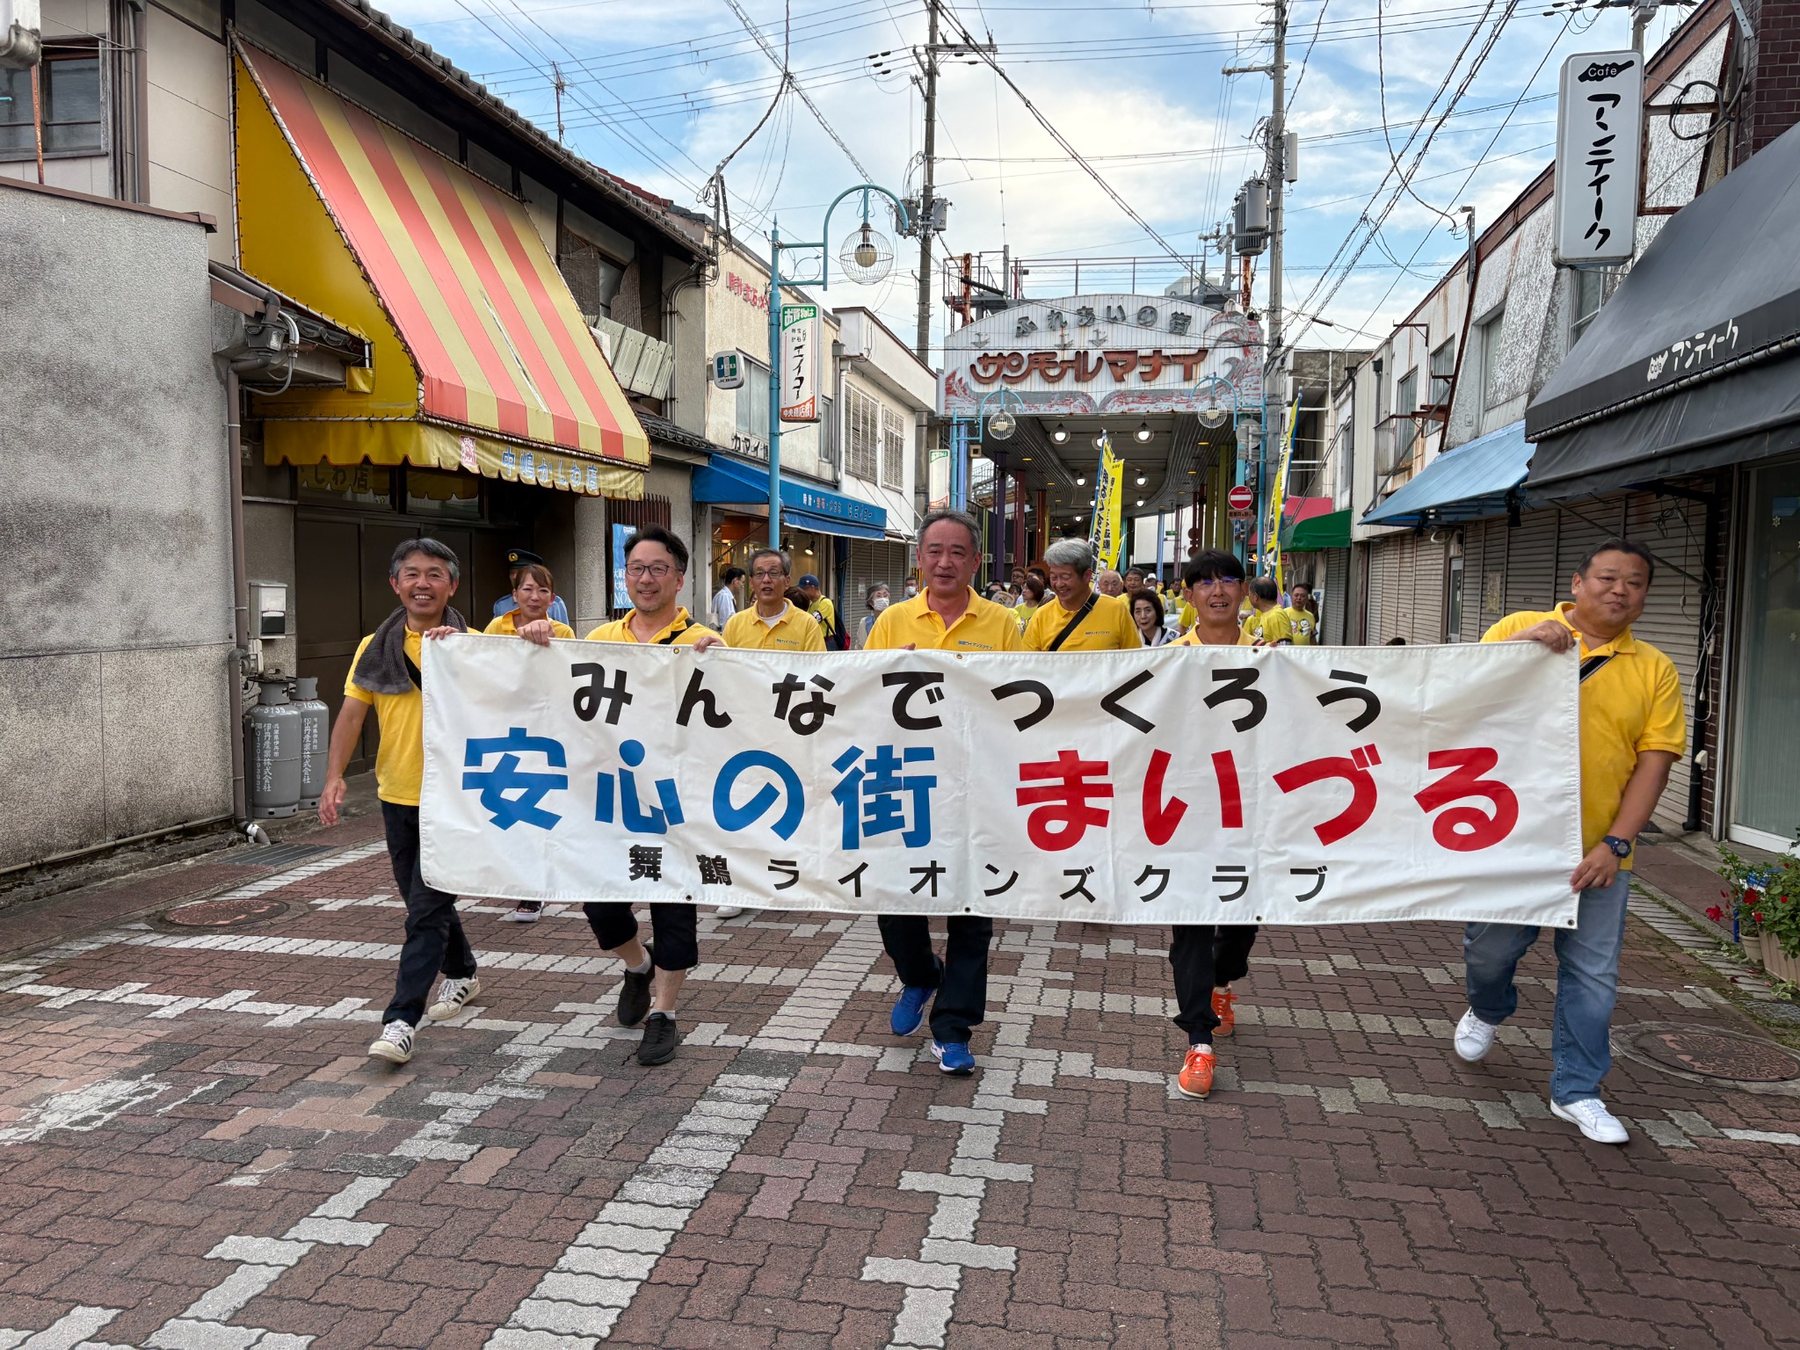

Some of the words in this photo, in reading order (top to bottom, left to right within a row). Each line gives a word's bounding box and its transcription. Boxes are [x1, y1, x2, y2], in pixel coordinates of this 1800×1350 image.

[1588, 66, 1618, 78] Cafe
[1583, 93, 1621, 251] アンティーク
[792, 344, 805, 400] エイコー
[970, 348, 1209, 385] サンモールマナイ
[1672, 318, 1739, 372] アンティーク
[571, 662, 1381, 736] みんなでつくろう
[462, 727, 937, 850] 安心の街
[1016, 743, 1519, 852] まいづる
[628, 844, 1328, 903] 舞鶴ライオンズクラブ
